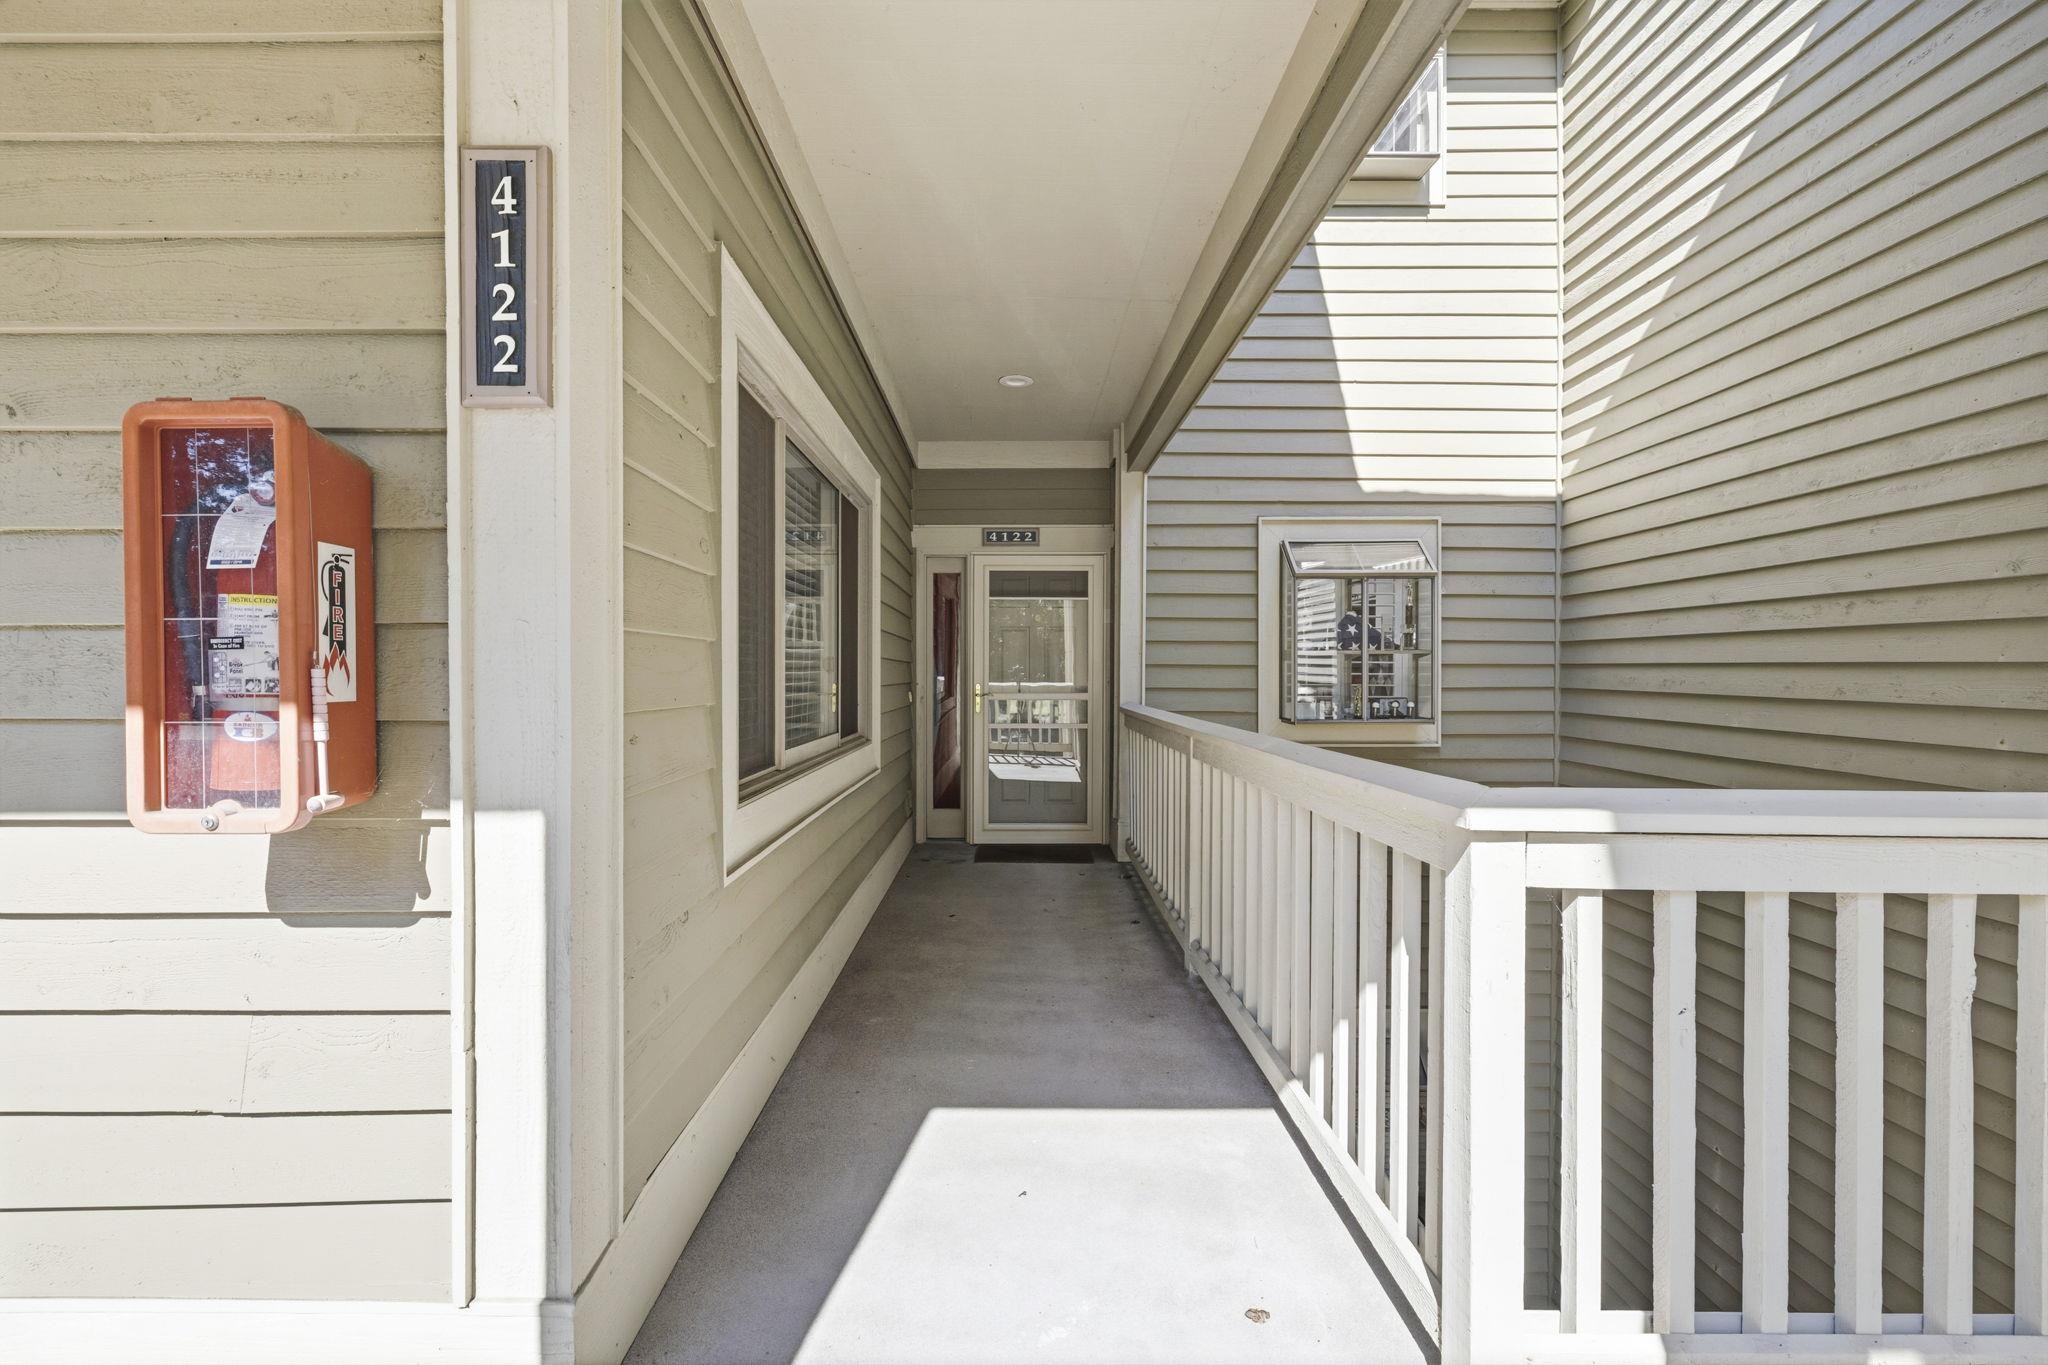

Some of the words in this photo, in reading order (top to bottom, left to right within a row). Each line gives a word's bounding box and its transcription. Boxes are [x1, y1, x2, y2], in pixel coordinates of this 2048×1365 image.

[491, 175, 518, 373] 4122
[989, 532, 1033, 541] 4122
[332, 570, 345, 641] FIRE
